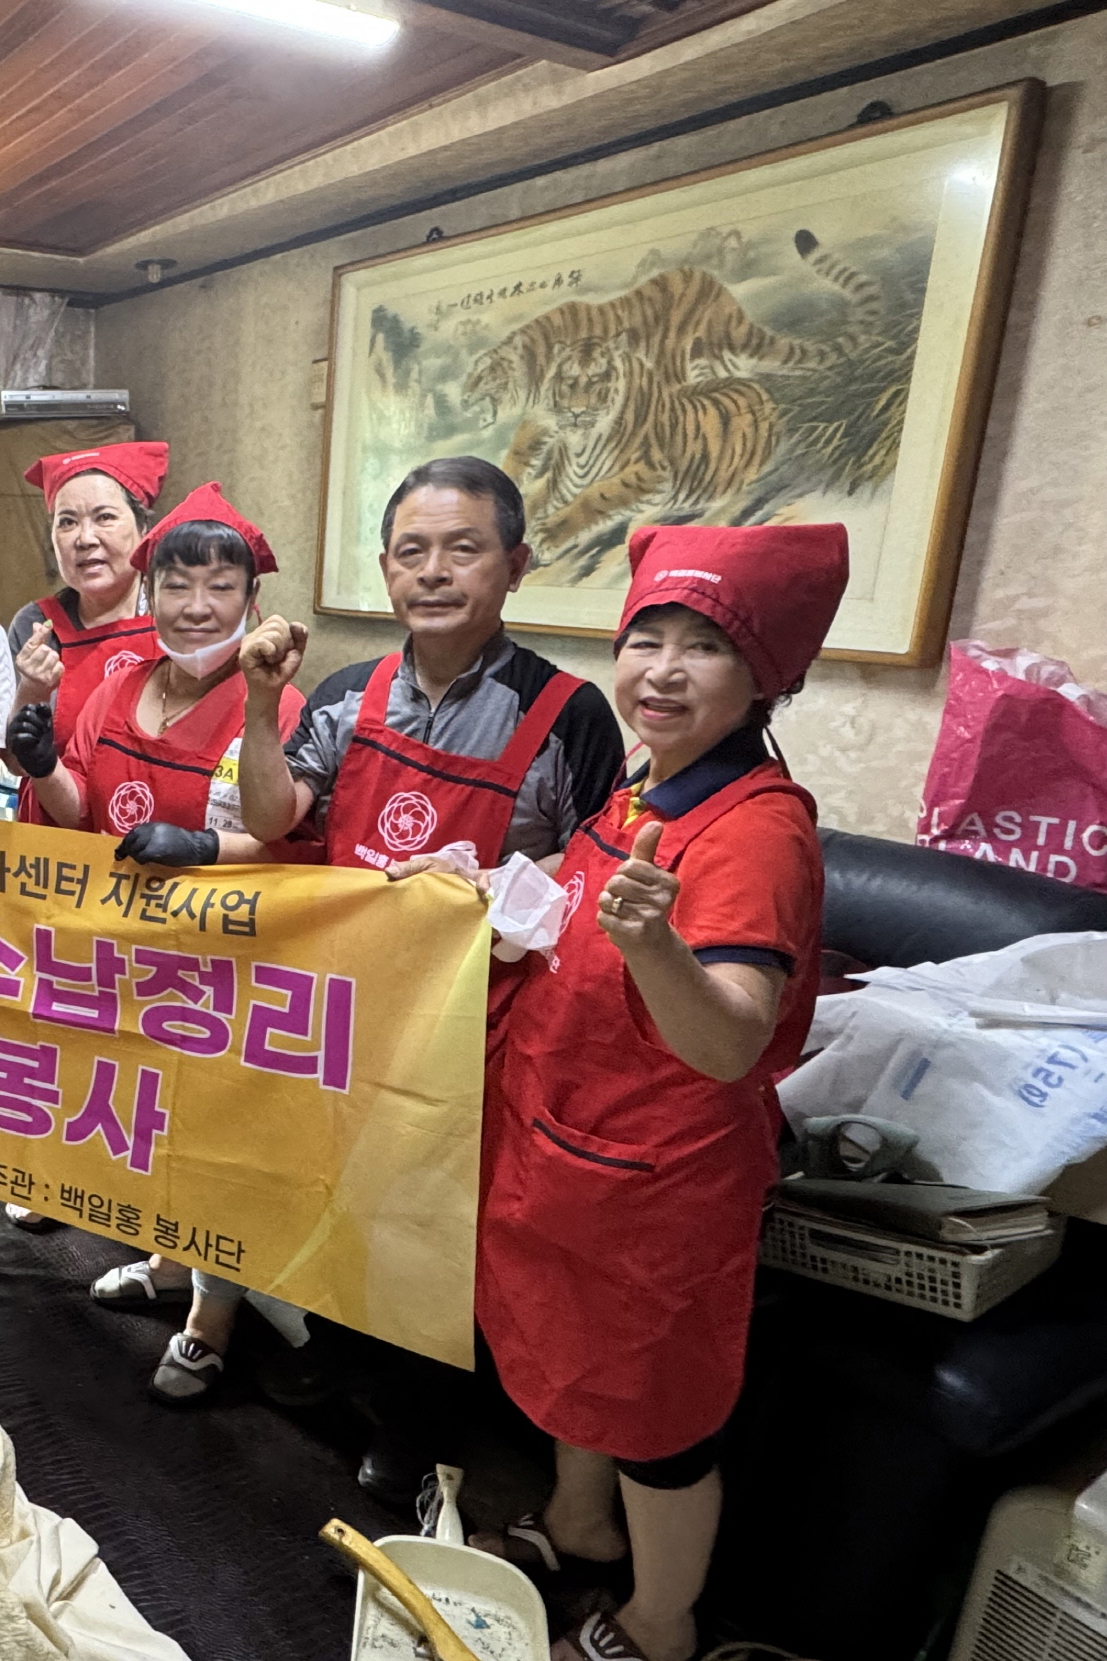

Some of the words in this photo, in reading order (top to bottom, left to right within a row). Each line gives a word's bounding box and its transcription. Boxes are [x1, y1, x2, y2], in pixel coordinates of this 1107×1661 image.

[99, 871, 262, 937] 지원사업
[59, 1182, 143, 1237] 백일홍
[153, 1213, 246, 1273] 봉사단
